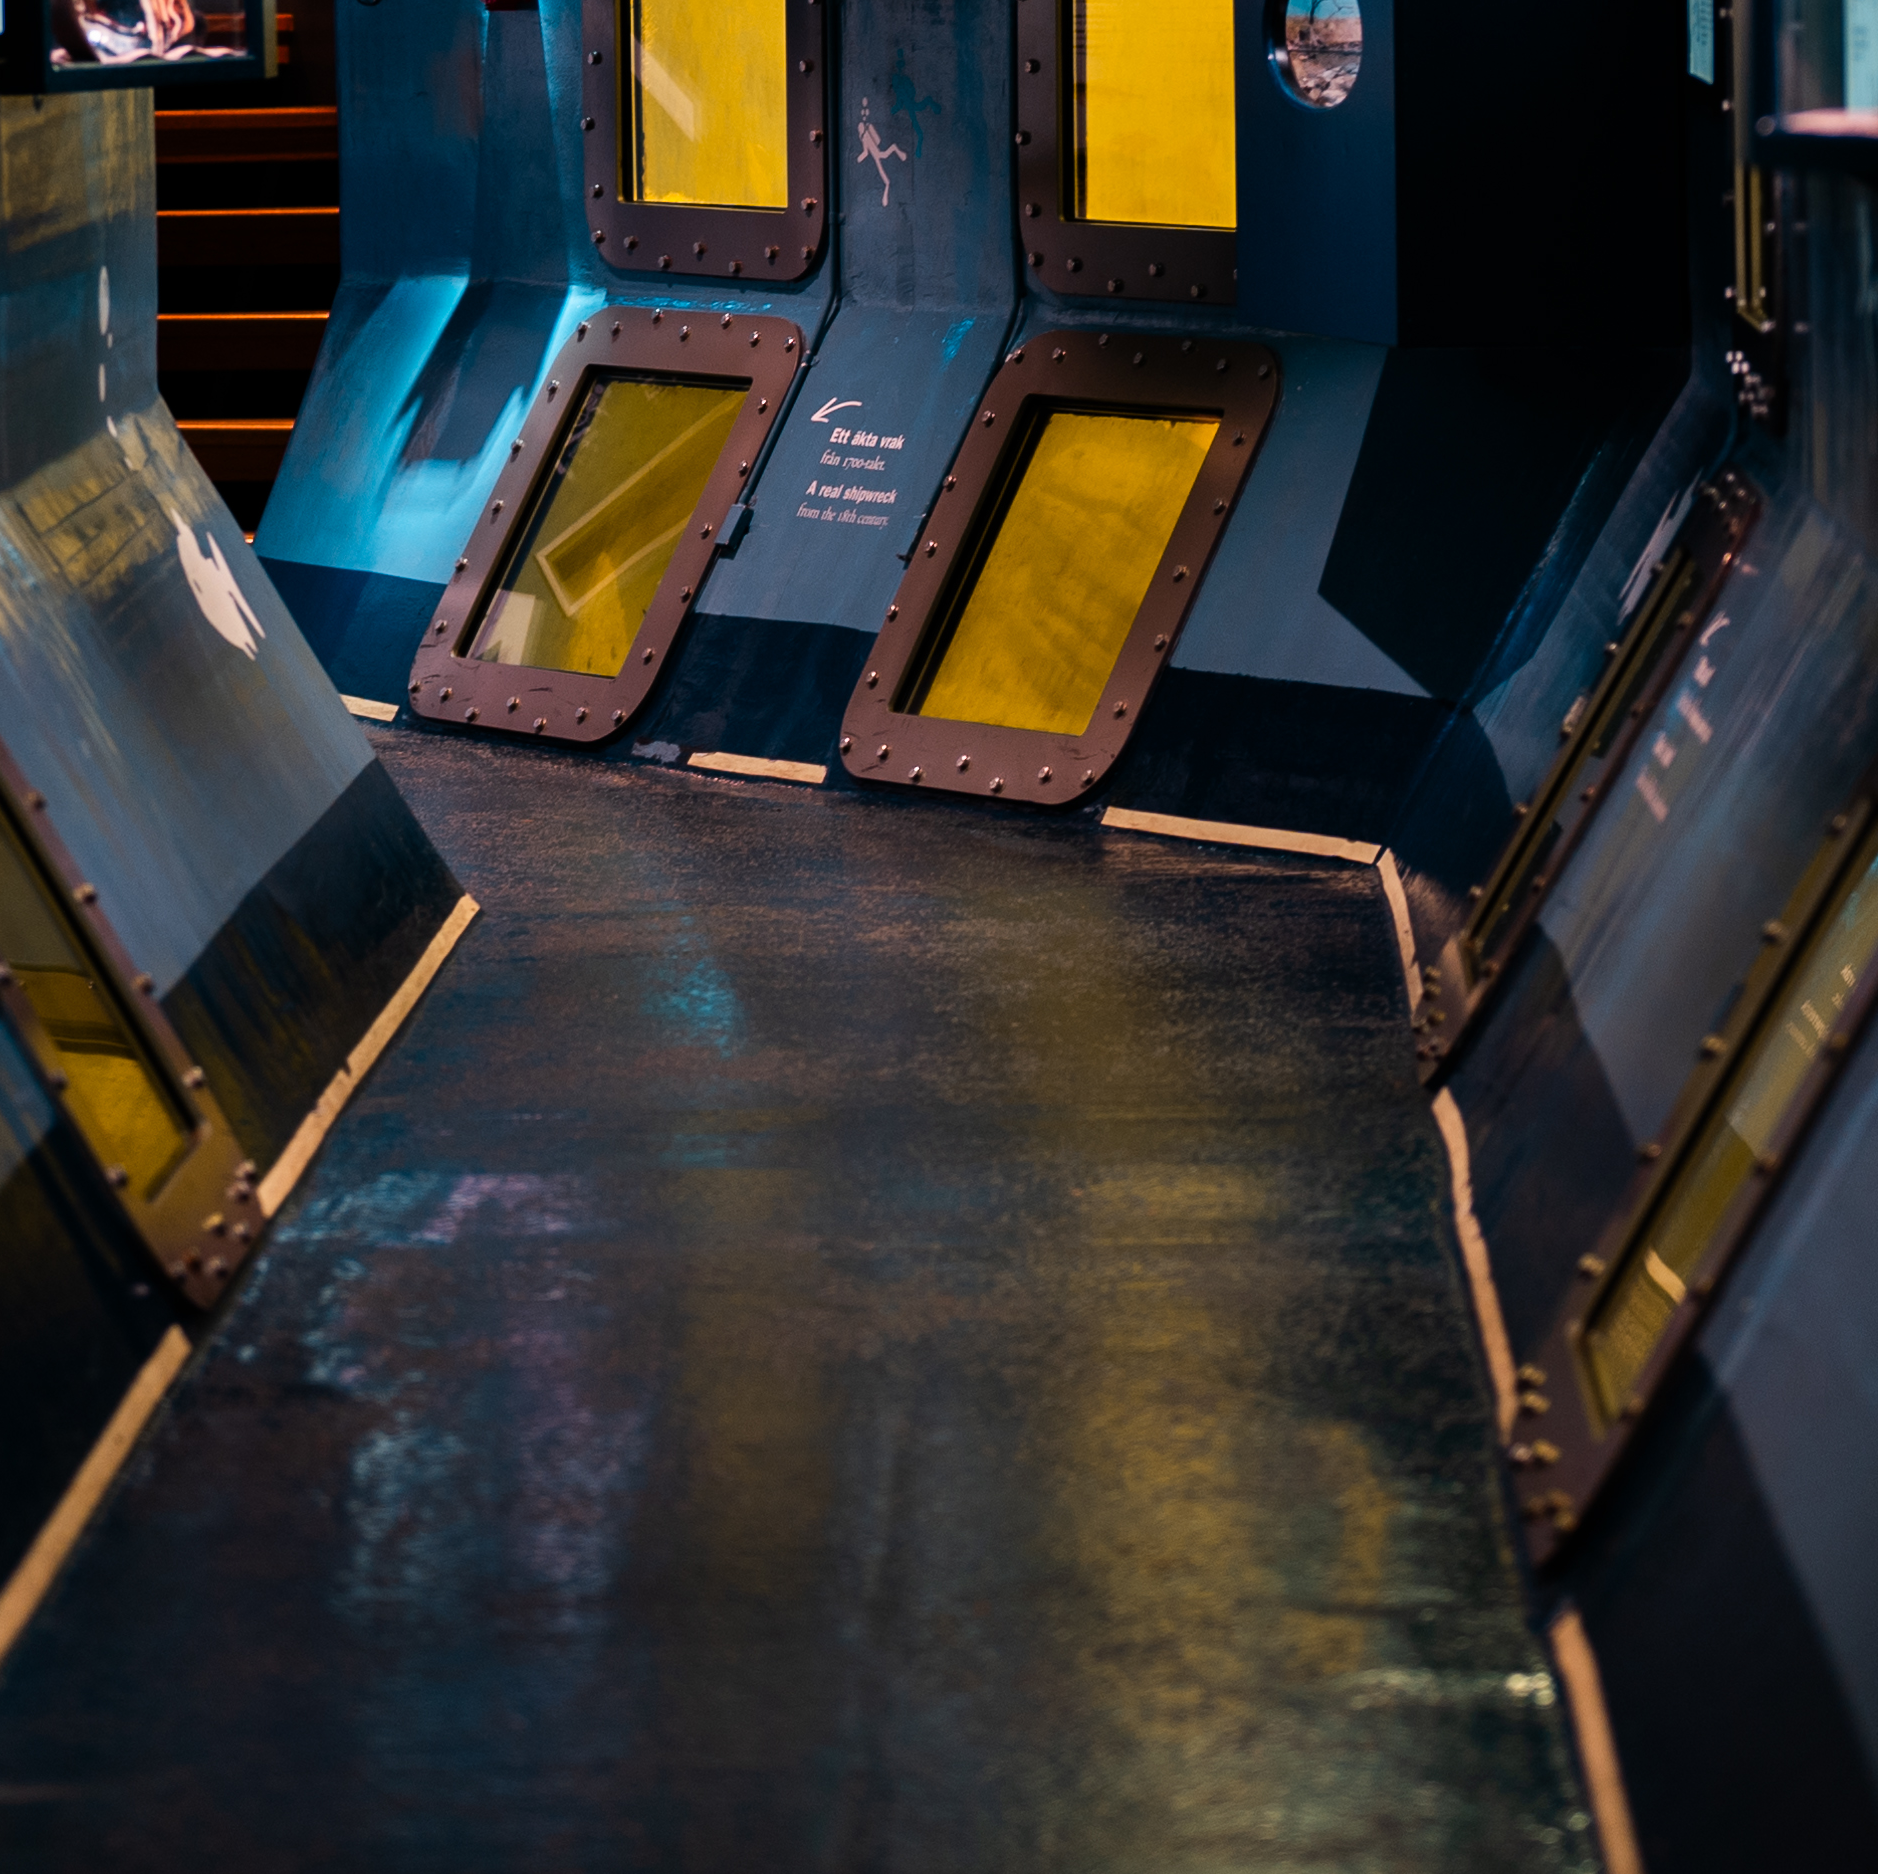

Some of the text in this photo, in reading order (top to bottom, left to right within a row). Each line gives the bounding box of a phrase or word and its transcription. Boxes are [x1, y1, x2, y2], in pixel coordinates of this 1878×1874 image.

[829, 427, 906, 450] Ett äkta vrak
[819, 448, 841, 467] från
[805, 480, 898, 505] A real shipwreck
[796, 501, 890, 530] from the 18th century.
